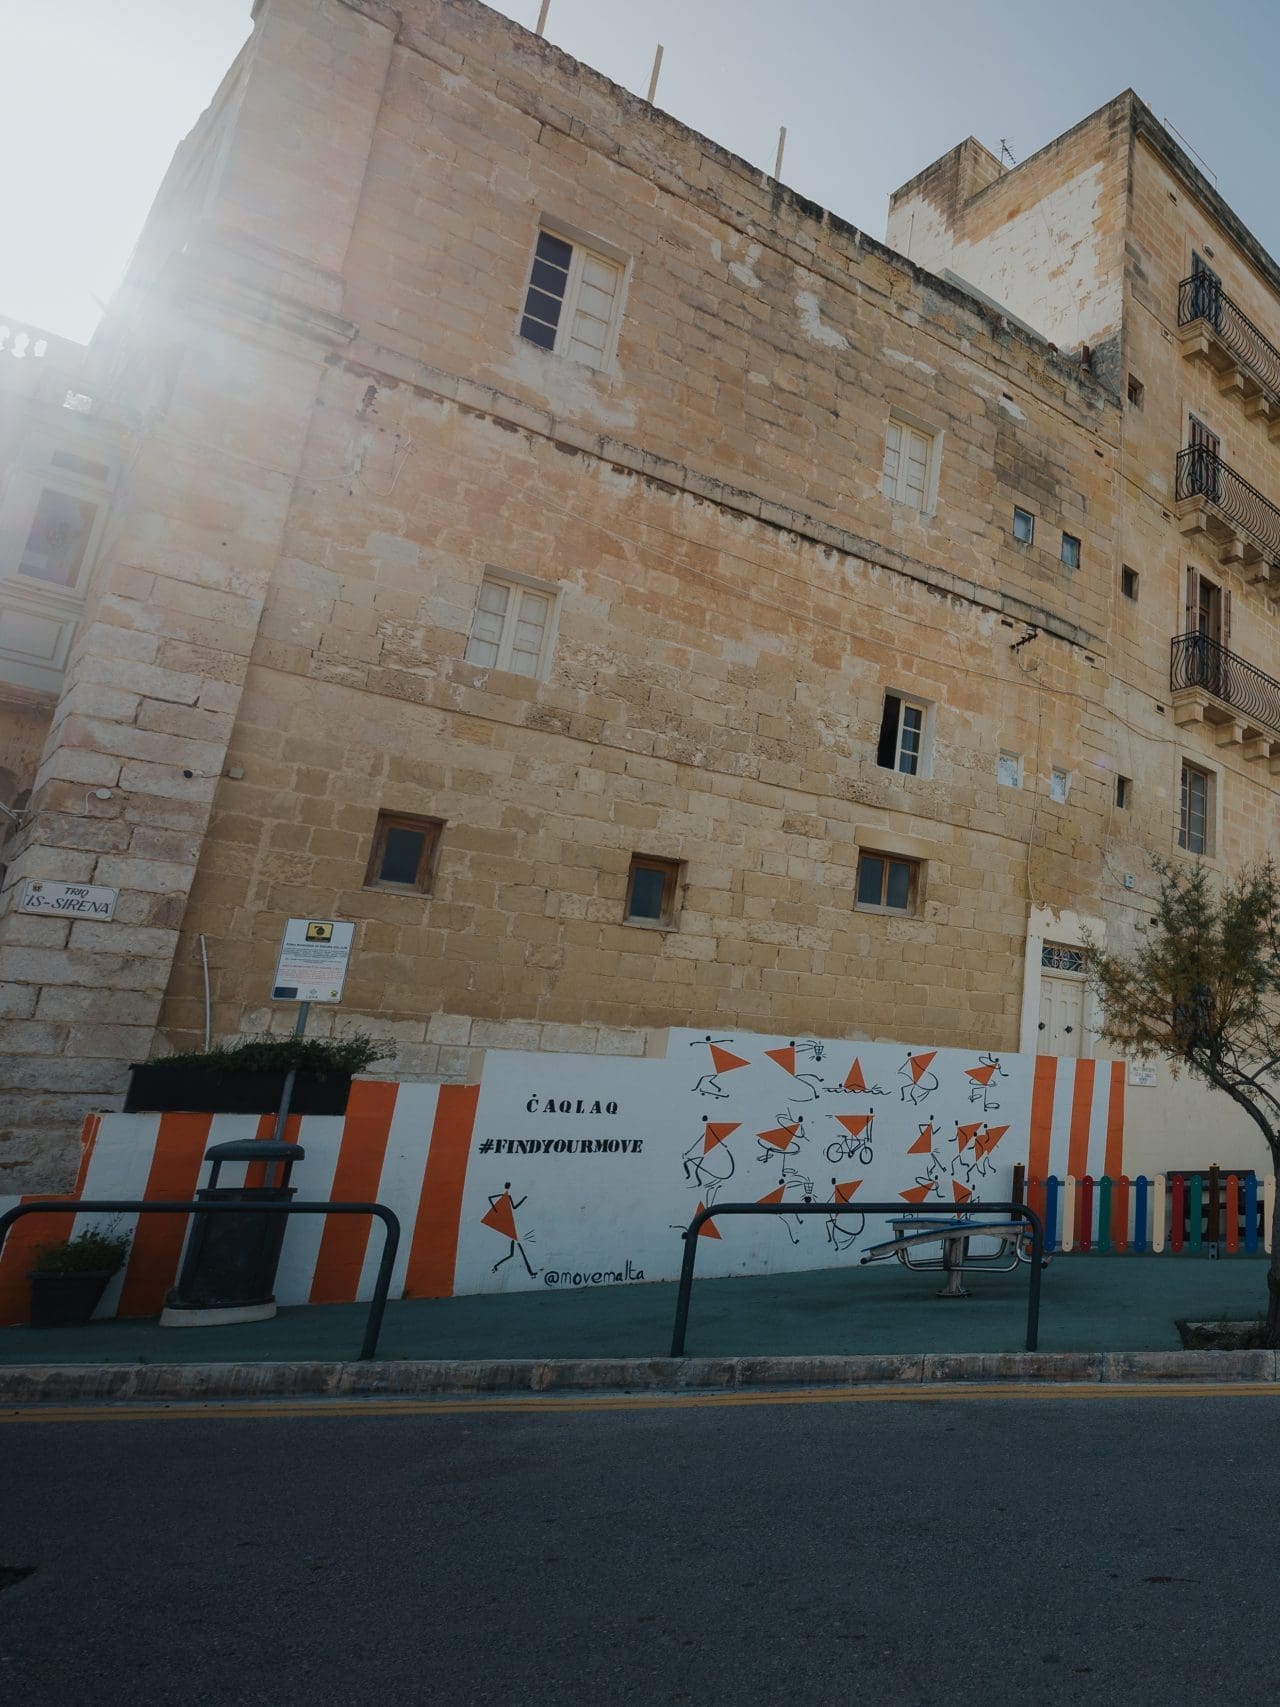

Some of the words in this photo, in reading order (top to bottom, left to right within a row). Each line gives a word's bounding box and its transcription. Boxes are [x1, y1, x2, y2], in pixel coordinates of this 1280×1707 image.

[64, 887, 89, 898] TRIQ
[26, 895, 109, 914] IS-SIRENA
[526, 1093, 619, 1115] ĊAQLAQ
[478, 1138, 643, 1155] #FINDYOURMOVE
[544, 1259, 645, 1286] @movemalta
